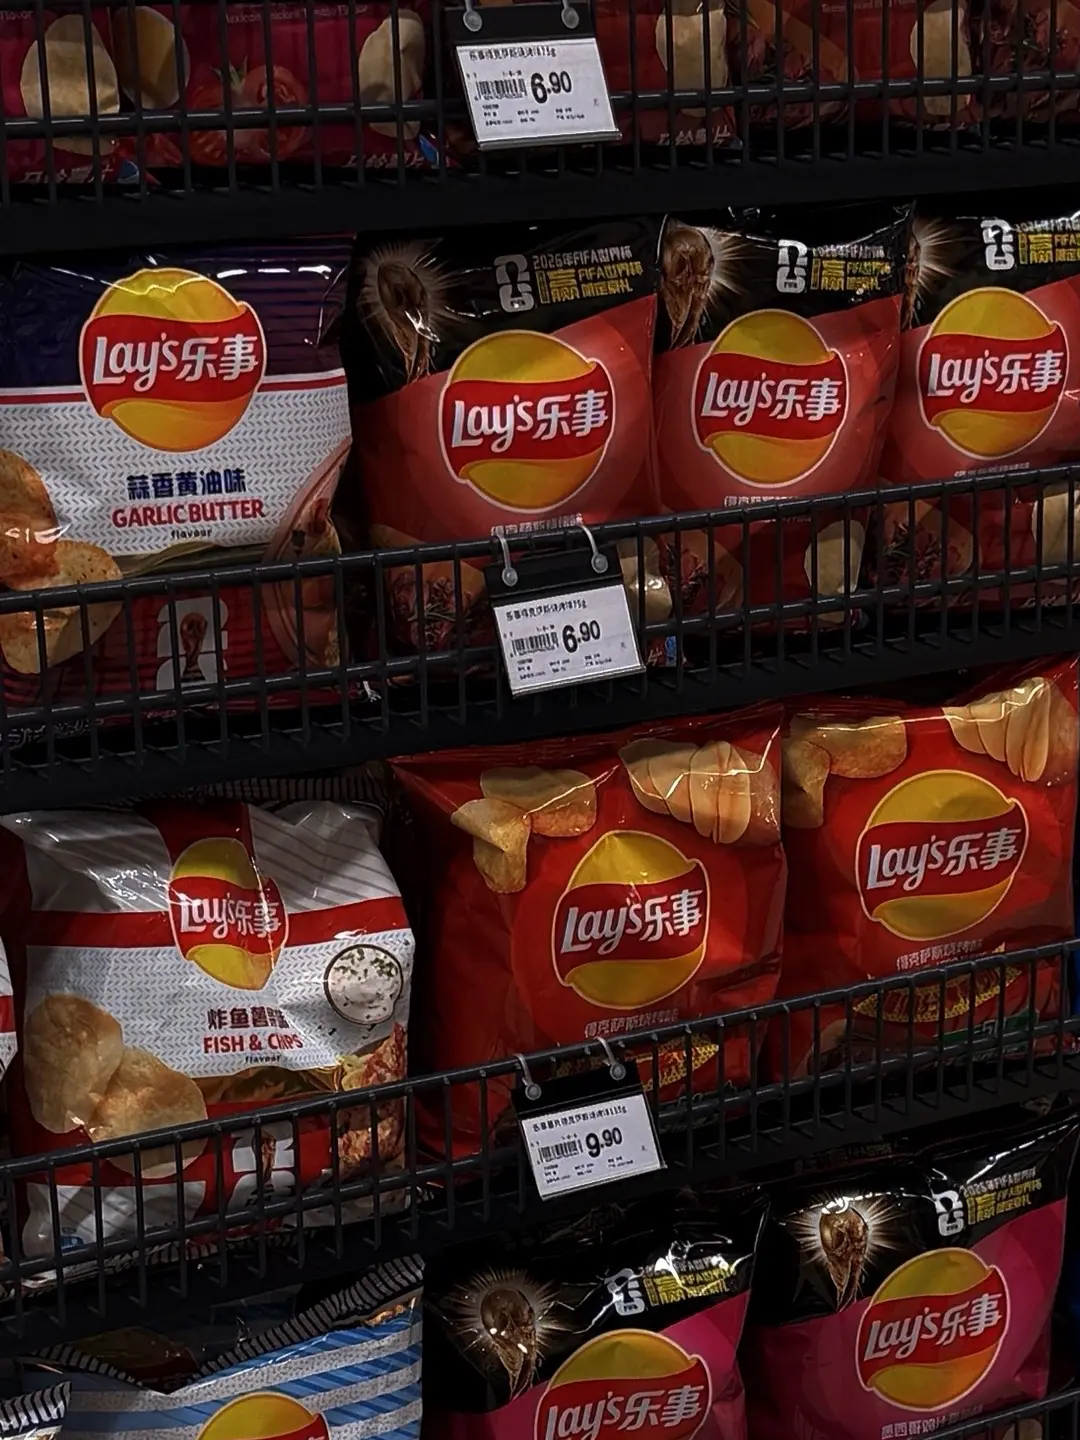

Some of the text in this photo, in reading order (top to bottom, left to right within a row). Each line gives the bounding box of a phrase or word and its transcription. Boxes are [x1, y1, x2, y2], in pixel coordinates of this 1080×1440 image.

[531, 71, 572, 104] 6.90
[126, 468, 246, 500] 蒜香黄油味
[112, 499, 265, 529] GARLIC BUTTER
[562, 620, 601, 653] 6.90
[203, 1035, 244, 1054] FISH
[249, 1034, 263, 1051] &
[585, 1127, 623, 1158] 9.90
